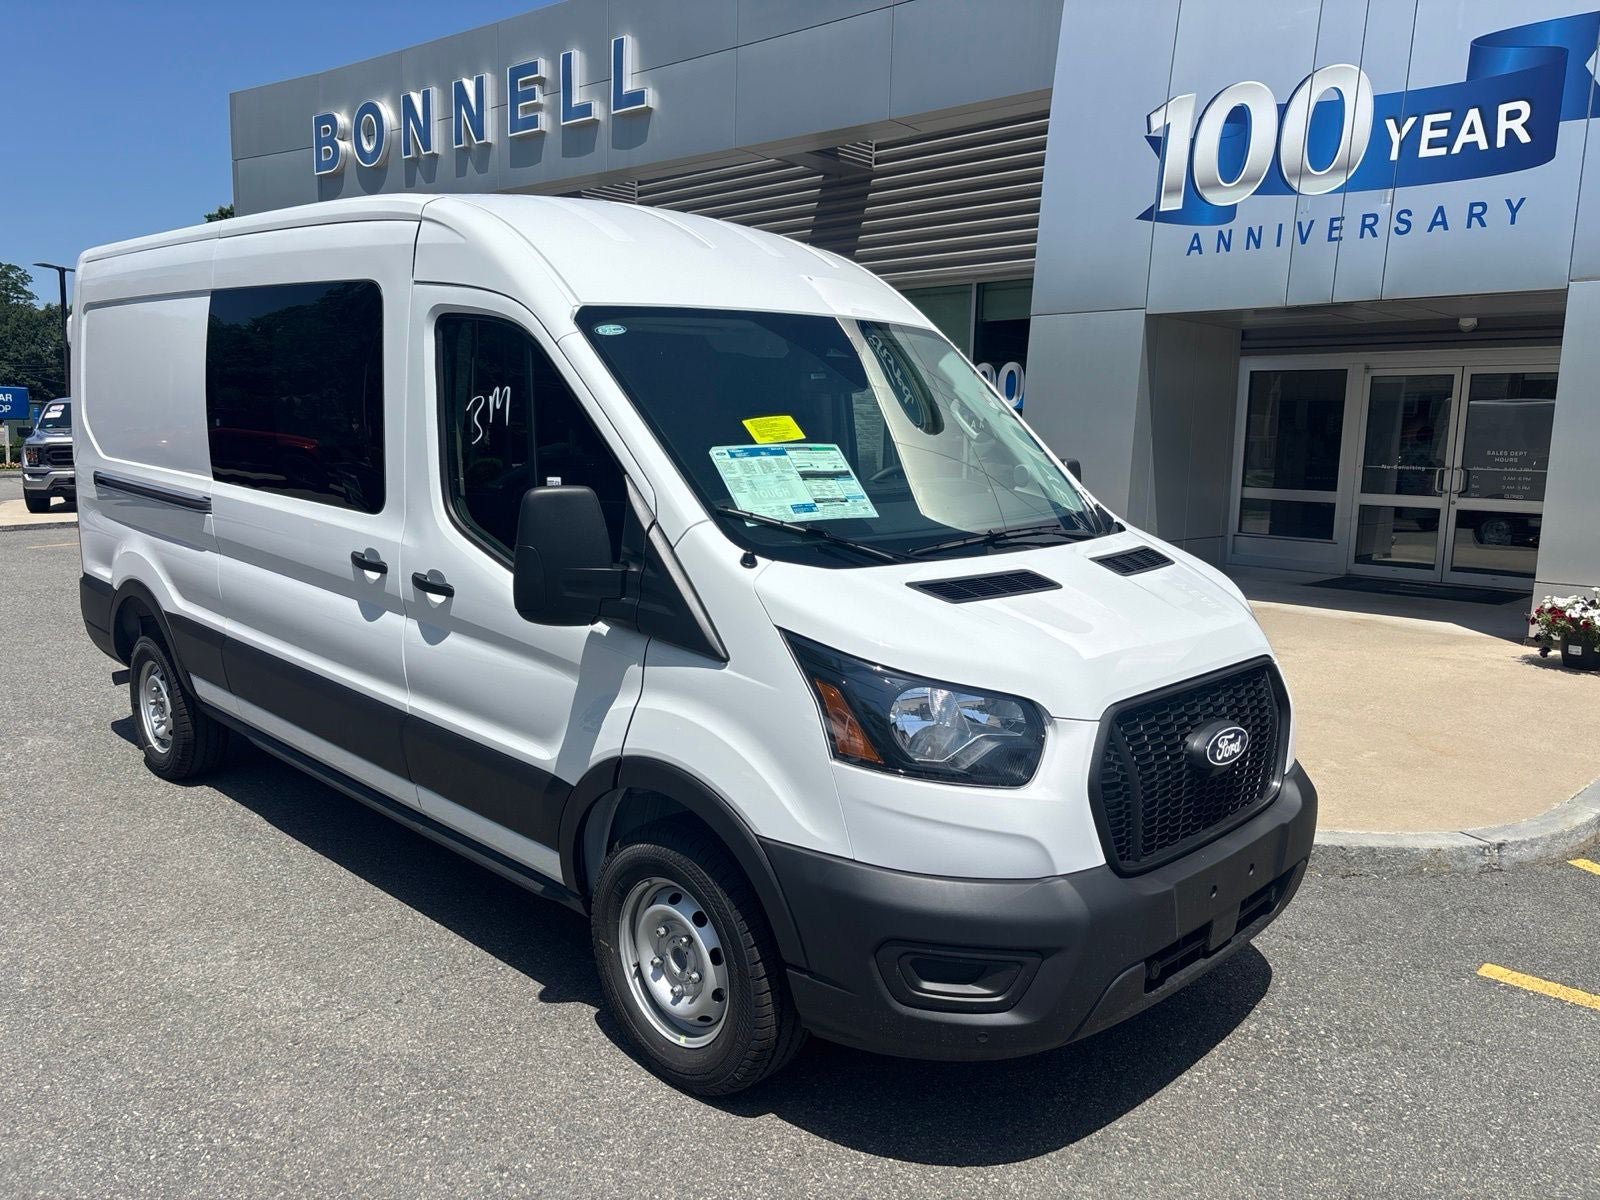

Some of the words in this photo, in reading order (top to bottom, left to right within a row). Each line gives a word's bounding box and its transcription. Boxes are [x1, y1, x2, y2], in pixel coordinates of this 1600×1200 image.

[312, 34, 654, 176] BONNELL
[1146, 63, 1374, 212] 100
[1384, 99, 1532, 162] YEAR
[1186, 197, 1527, 257] ANNIVERSARY
[1216, 733, 1242, 761] Ford
